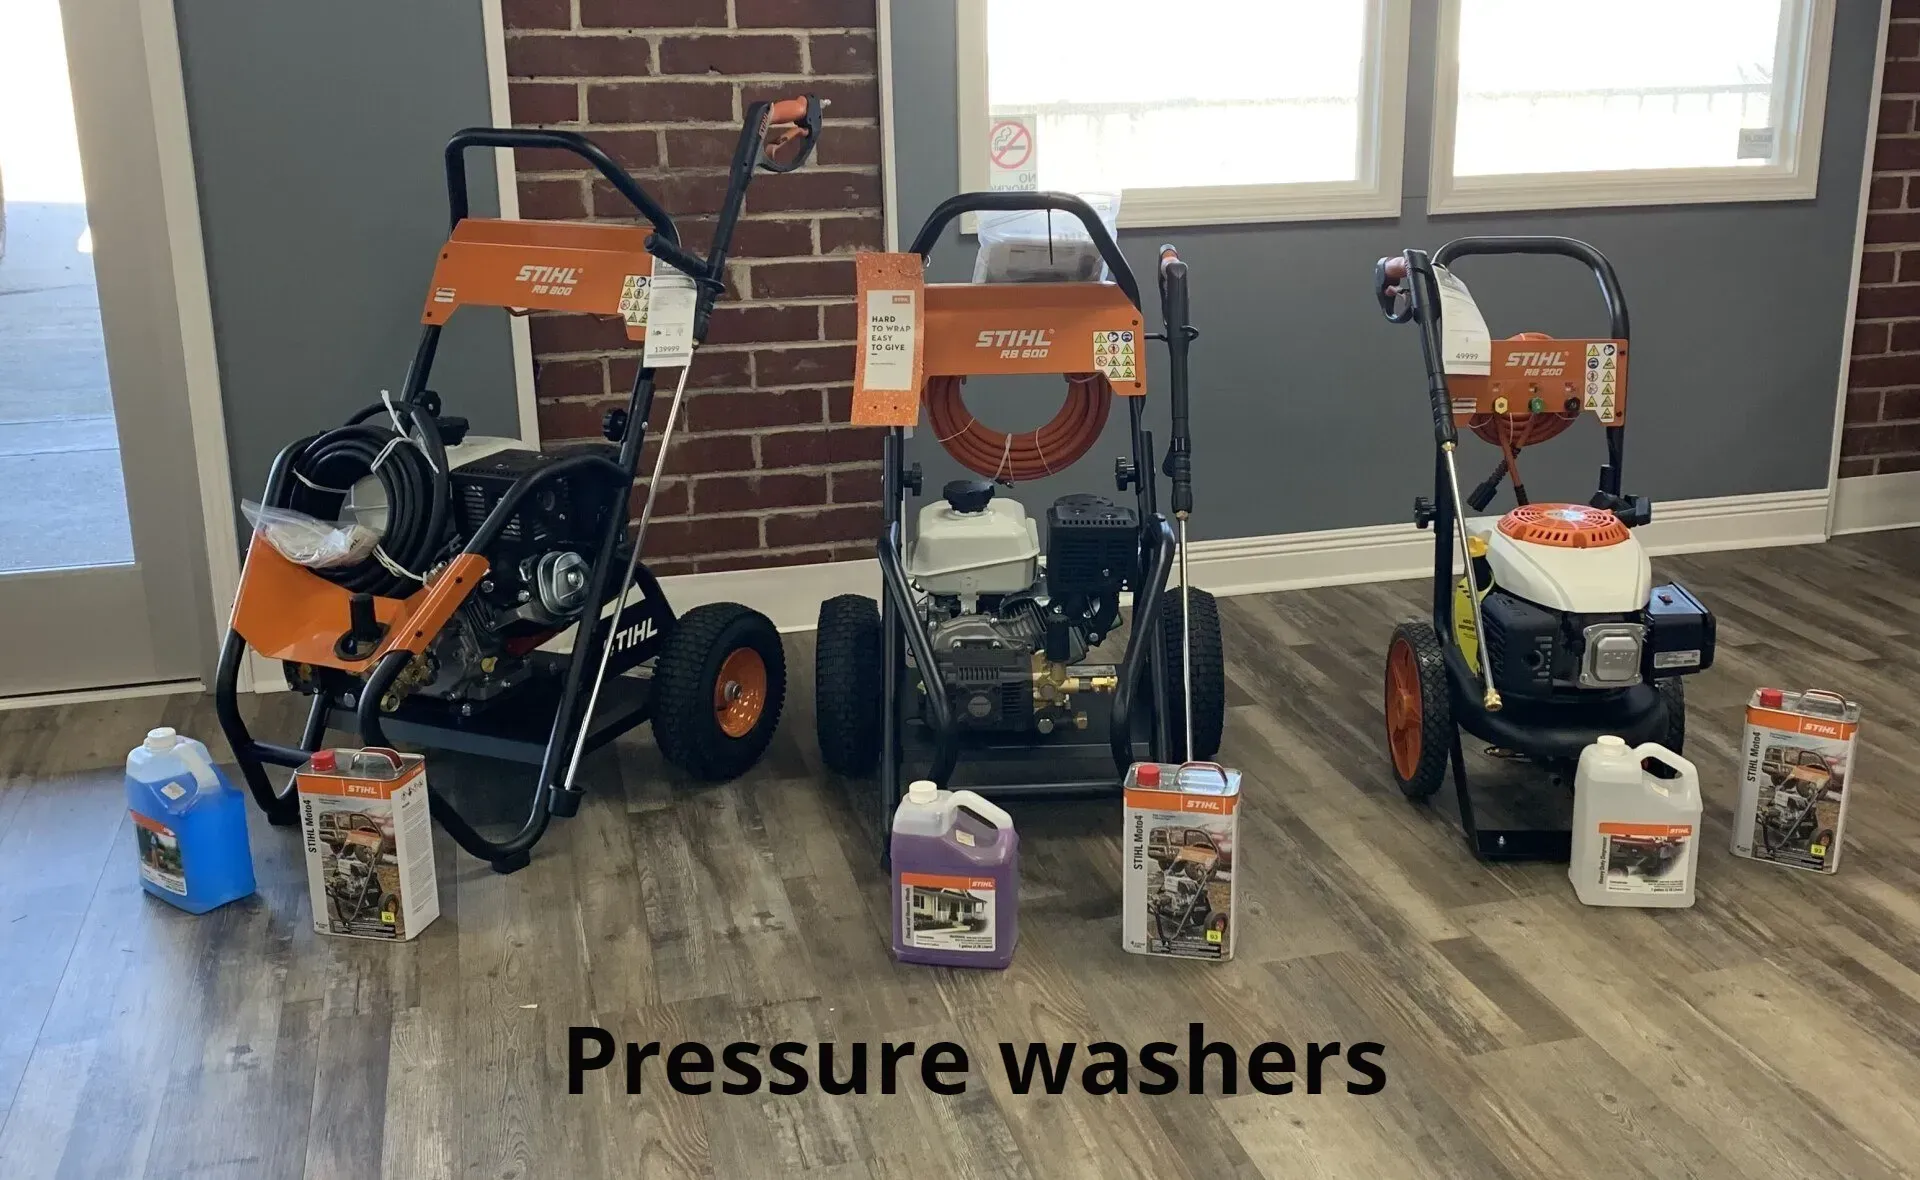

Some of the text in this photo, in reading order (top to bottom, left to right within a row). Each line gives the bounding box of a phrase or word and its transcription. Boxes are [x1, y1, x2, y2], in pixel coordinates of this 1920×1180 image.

[515, 265, 578, 284] STIHL
[531, 285, 548, 294] RB
[976, 330, 1052, 347] STIHL
[1000, 349, 1048, 359] RB 600
[1505, 352, 1566, 366] STIHL
[1524, 368, 1563, 376] RB 200
[1804, 723, 1837, 735] STIHL
[1747, 732, 1760, 782] STIHL Moto4
[348, 785, 377, 794] STIHL
[1186, 800, 1220, 809] STIHL
[303, 800, 316, 853] STIHL Moto4
[1134, 815, 1143, 870] STIHL Moto4
